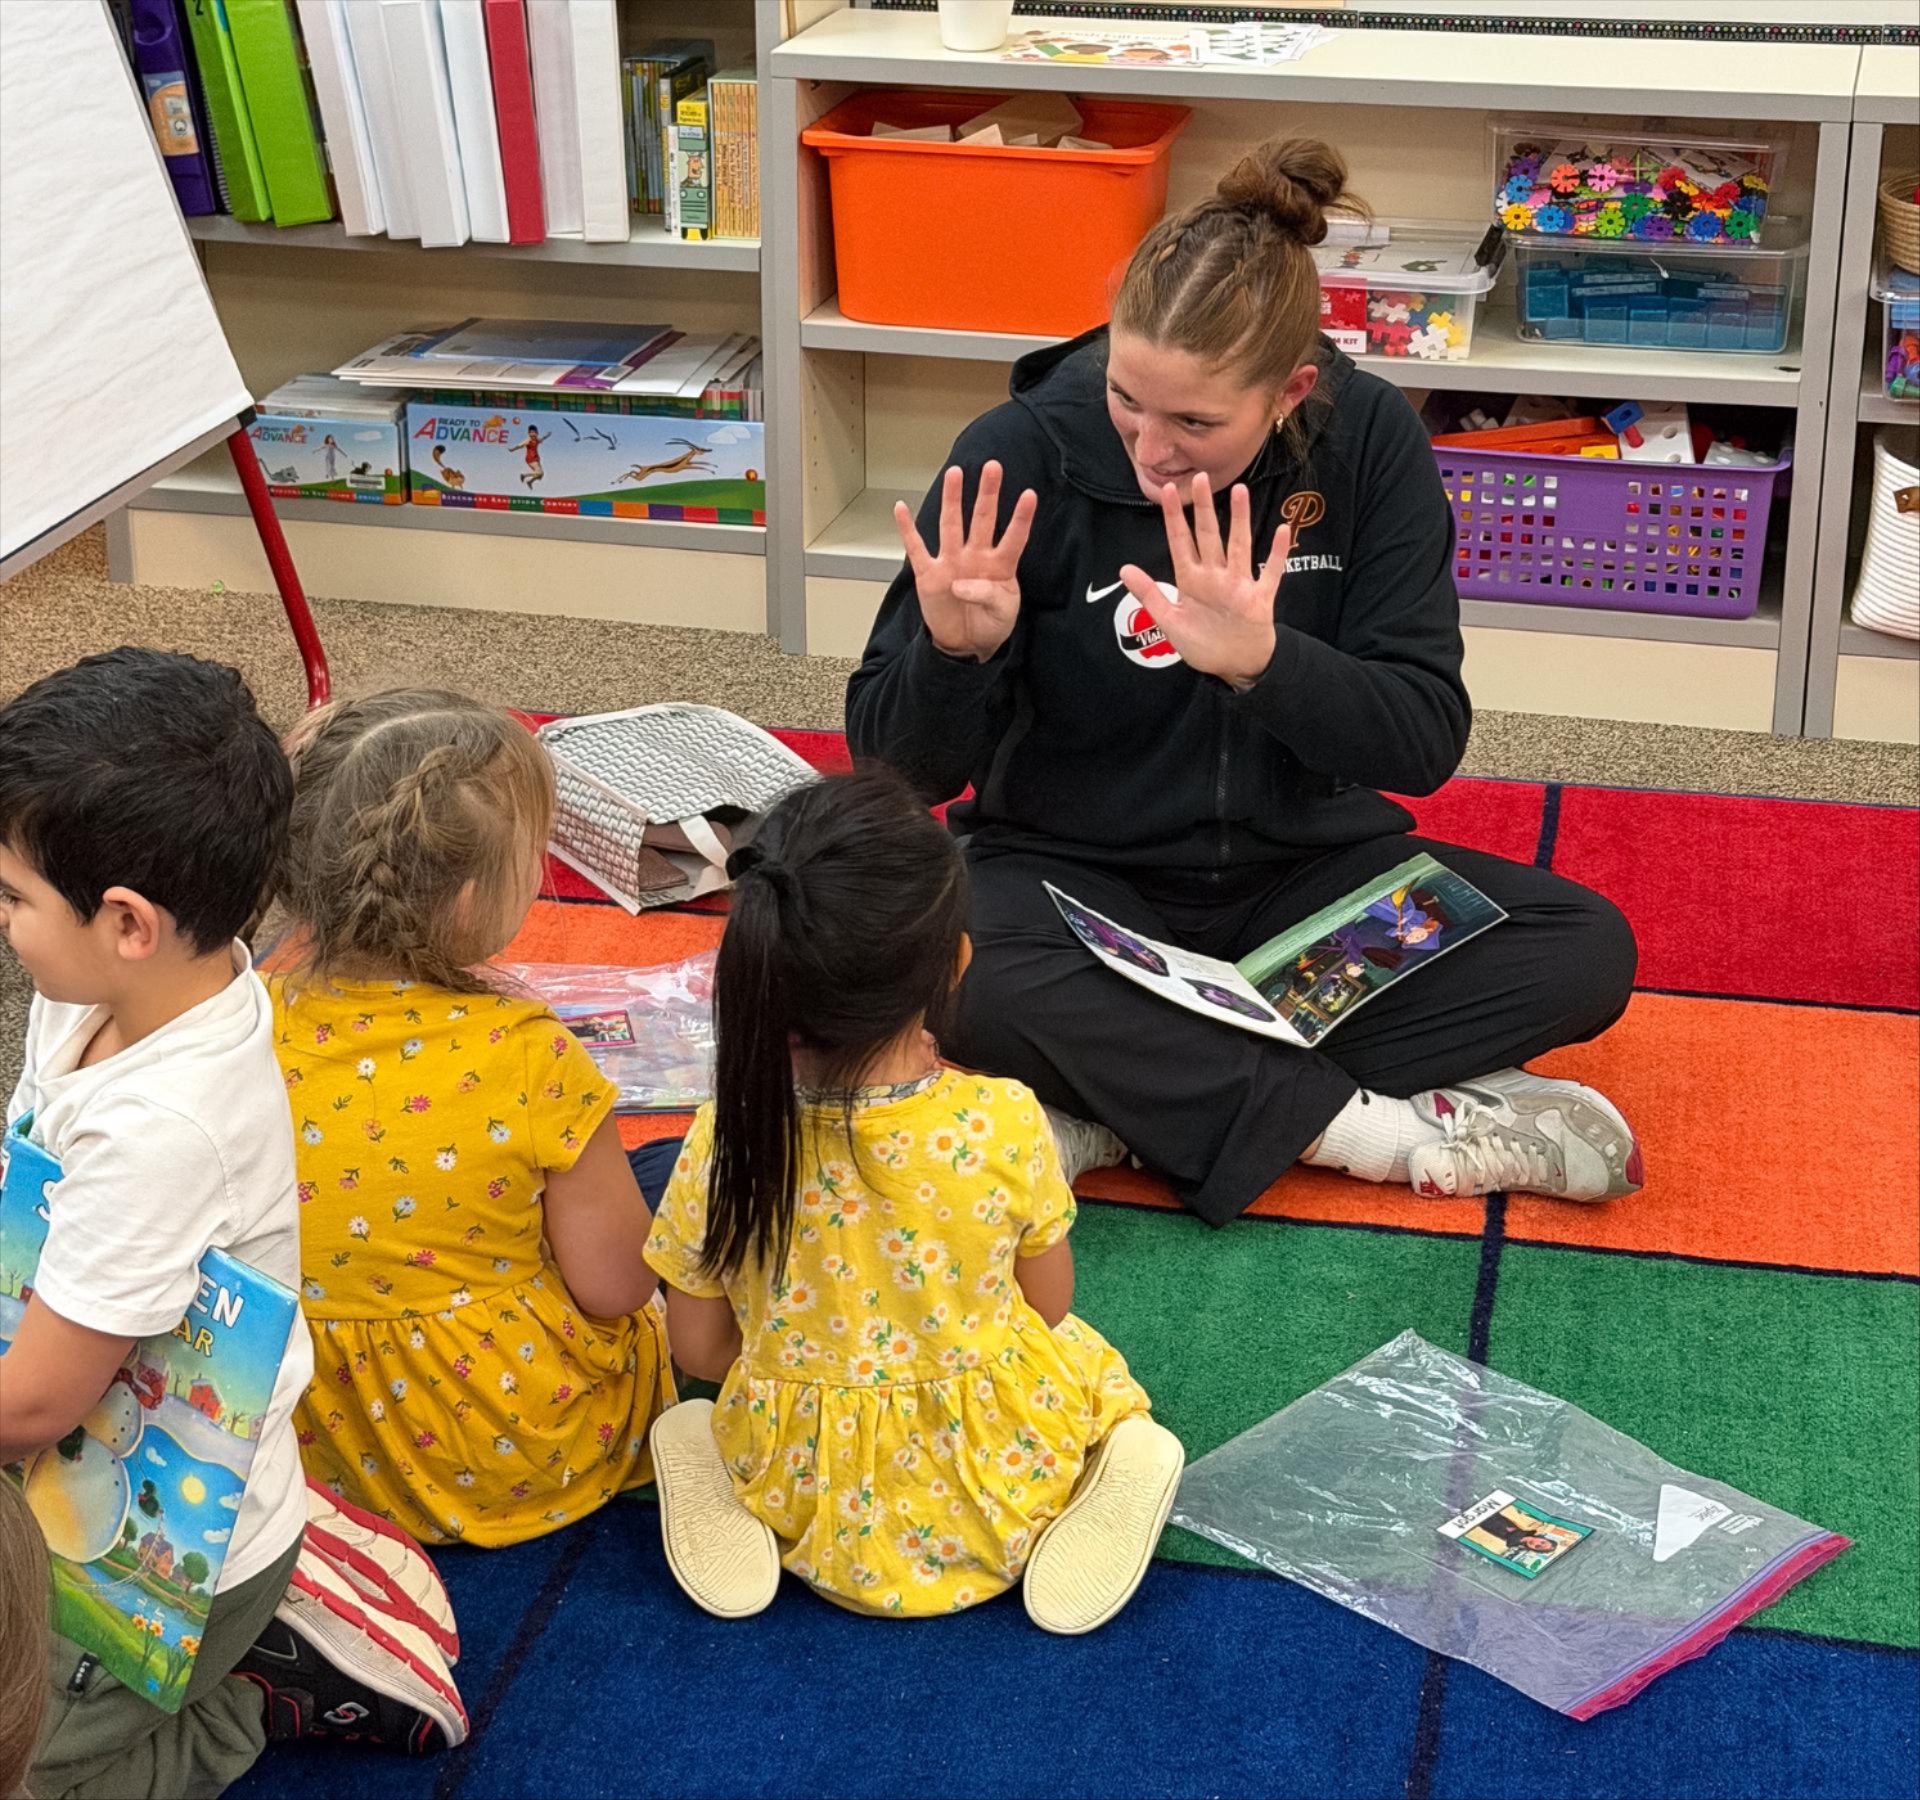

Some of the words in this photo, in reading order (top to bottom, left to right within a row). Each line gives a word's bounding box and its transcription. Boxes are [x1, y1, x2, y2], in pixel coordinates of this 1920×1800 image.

[413, 417, 509, 444] ADVANCE
[438, 417, 465, 427] READY
[470, 419, 481, 427] TO
[1280, 491, 1325, 548] P
[193, 1270, 245, 1329] EN
[172, 1314, 216, 1358] AR
[1452, 1498, 1501, 1529] Margot
